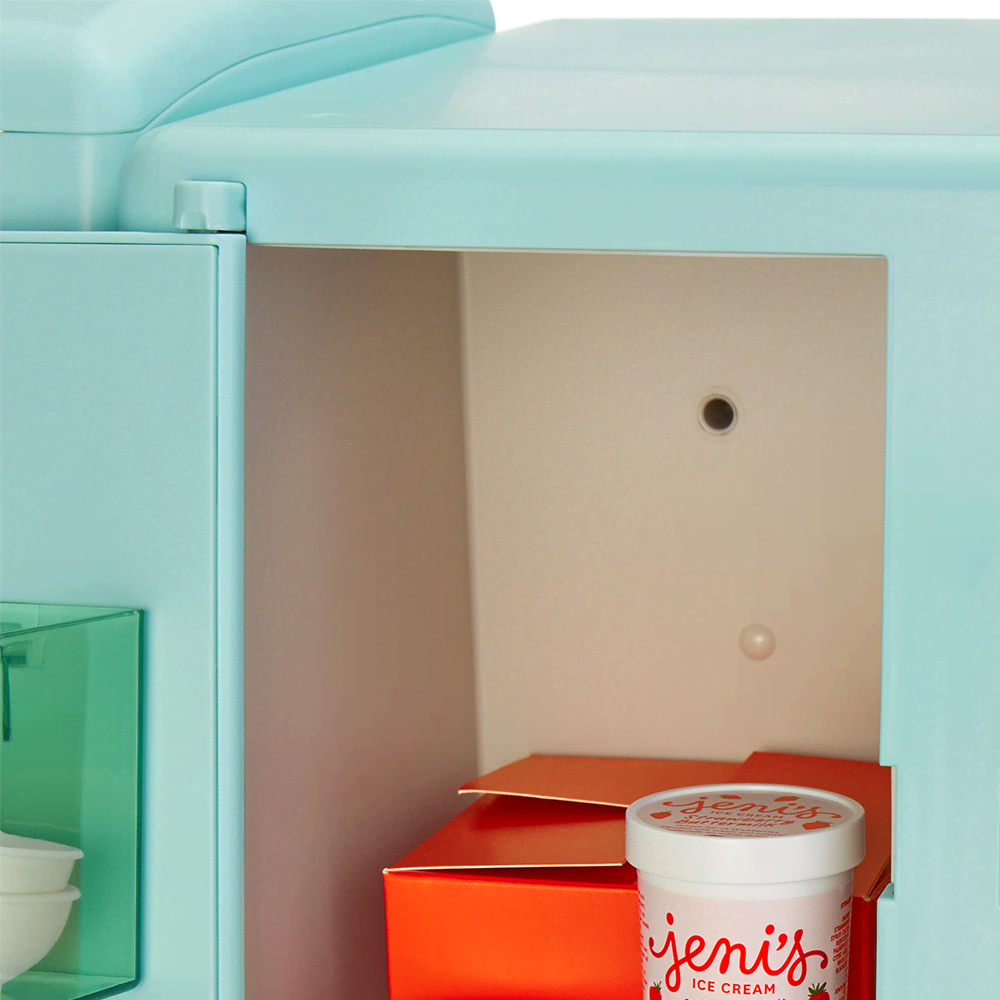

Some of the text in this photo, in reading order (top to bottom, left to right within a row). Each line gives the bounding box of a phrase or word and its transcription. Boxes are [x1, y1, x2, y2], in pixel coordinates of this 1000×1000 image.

[649, 912, 828, 993] jeni's
[692, 978, 776, 994] ICE CREAM
